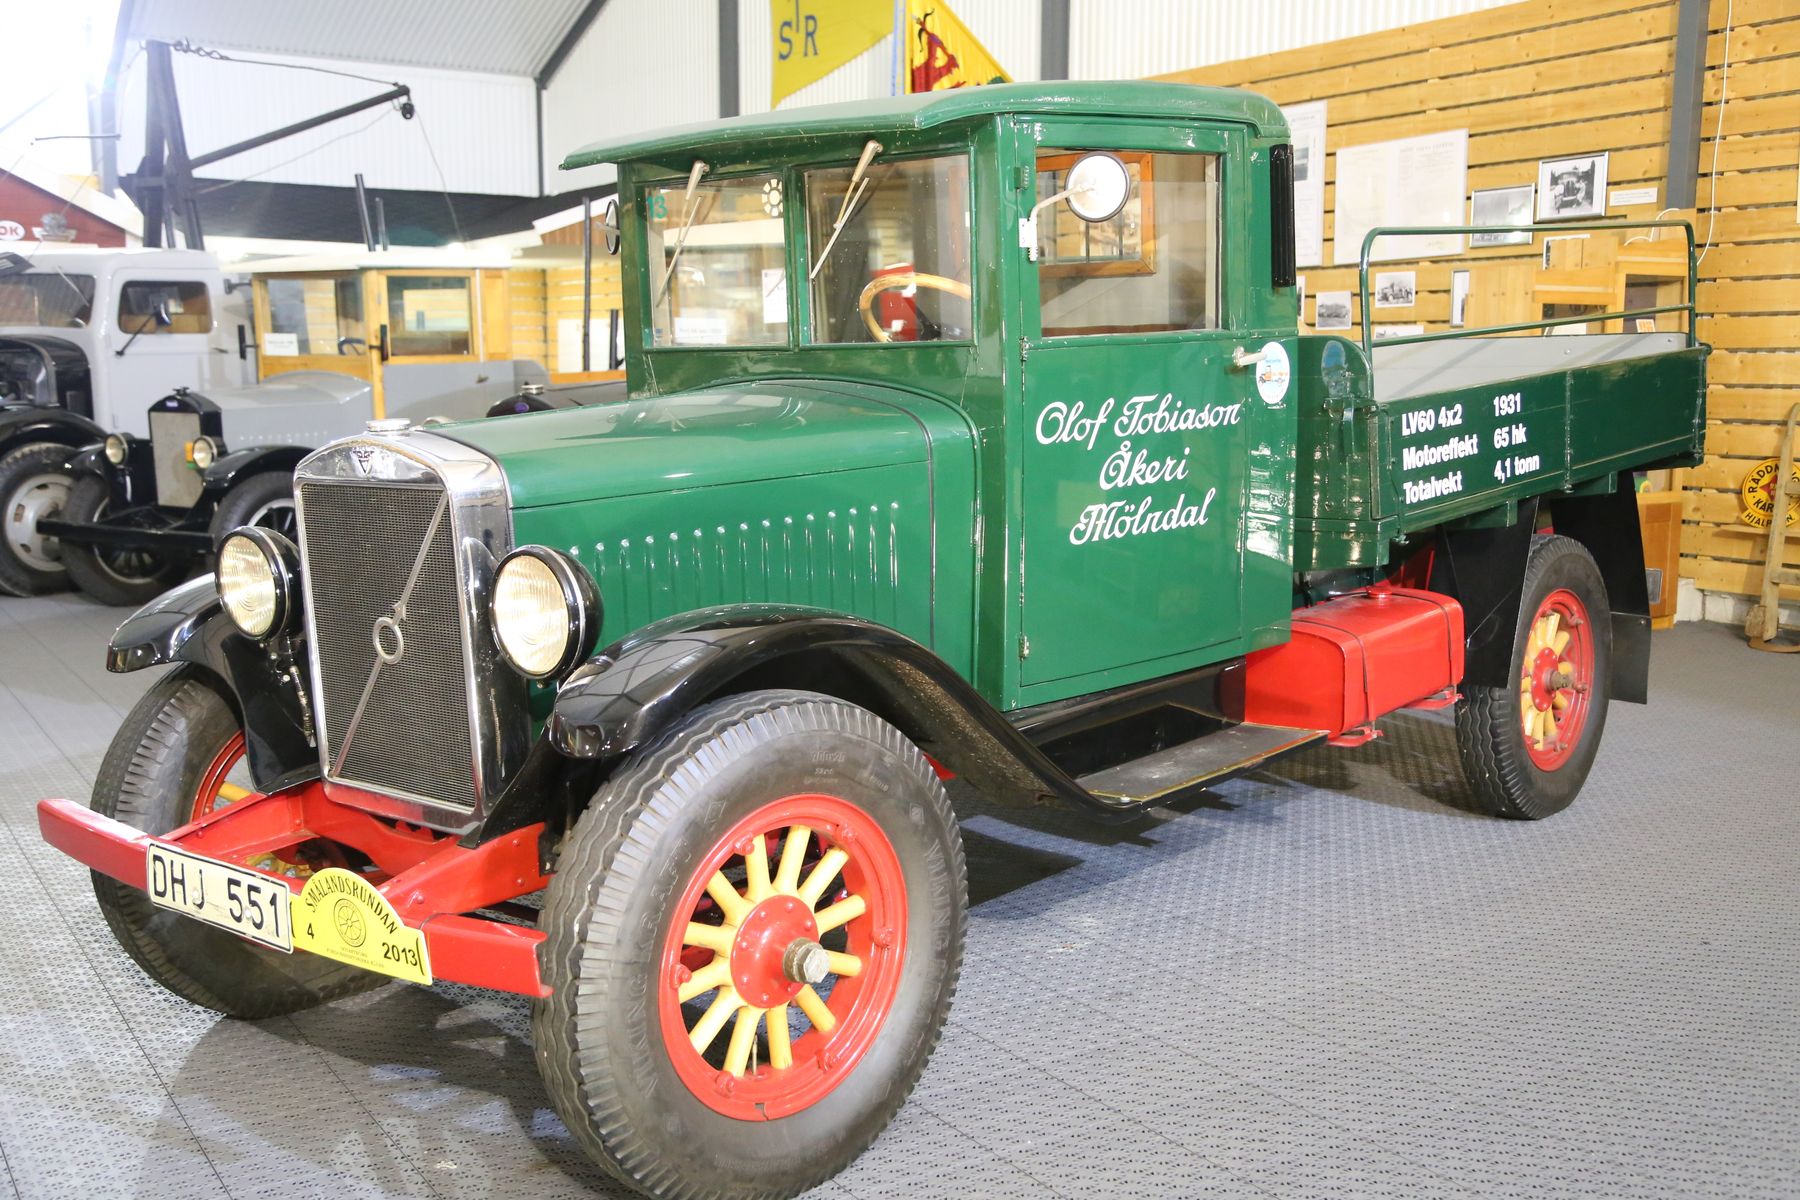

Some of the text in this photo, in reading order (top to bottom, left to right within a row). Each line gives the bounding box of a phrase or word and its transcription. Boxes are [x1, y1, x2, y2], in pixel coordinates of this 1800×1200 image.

[646, 195, 668, 219] 13
[1035, 397, 1114, 450] Olof
[1402, 392, 1521, 436] LV60 4x2 1931
[1099, 440, 1190, 490] Åkeri
[1402, 423, 1527, 470] Motoreffekt 65 hk
[1403, 454, 1540, 504] Totalvekt 4,1 tonn
[1069, 487, 1216, 545] Mölndal
[152, 854, 205, 910] DHJ
[227, 877, 280, 938] 551
[304, 874, 398, 935] SMÅLANDSRUNDAN
[306, 922, 315, 939] 4
[381, 942, 418, 967] 2013
